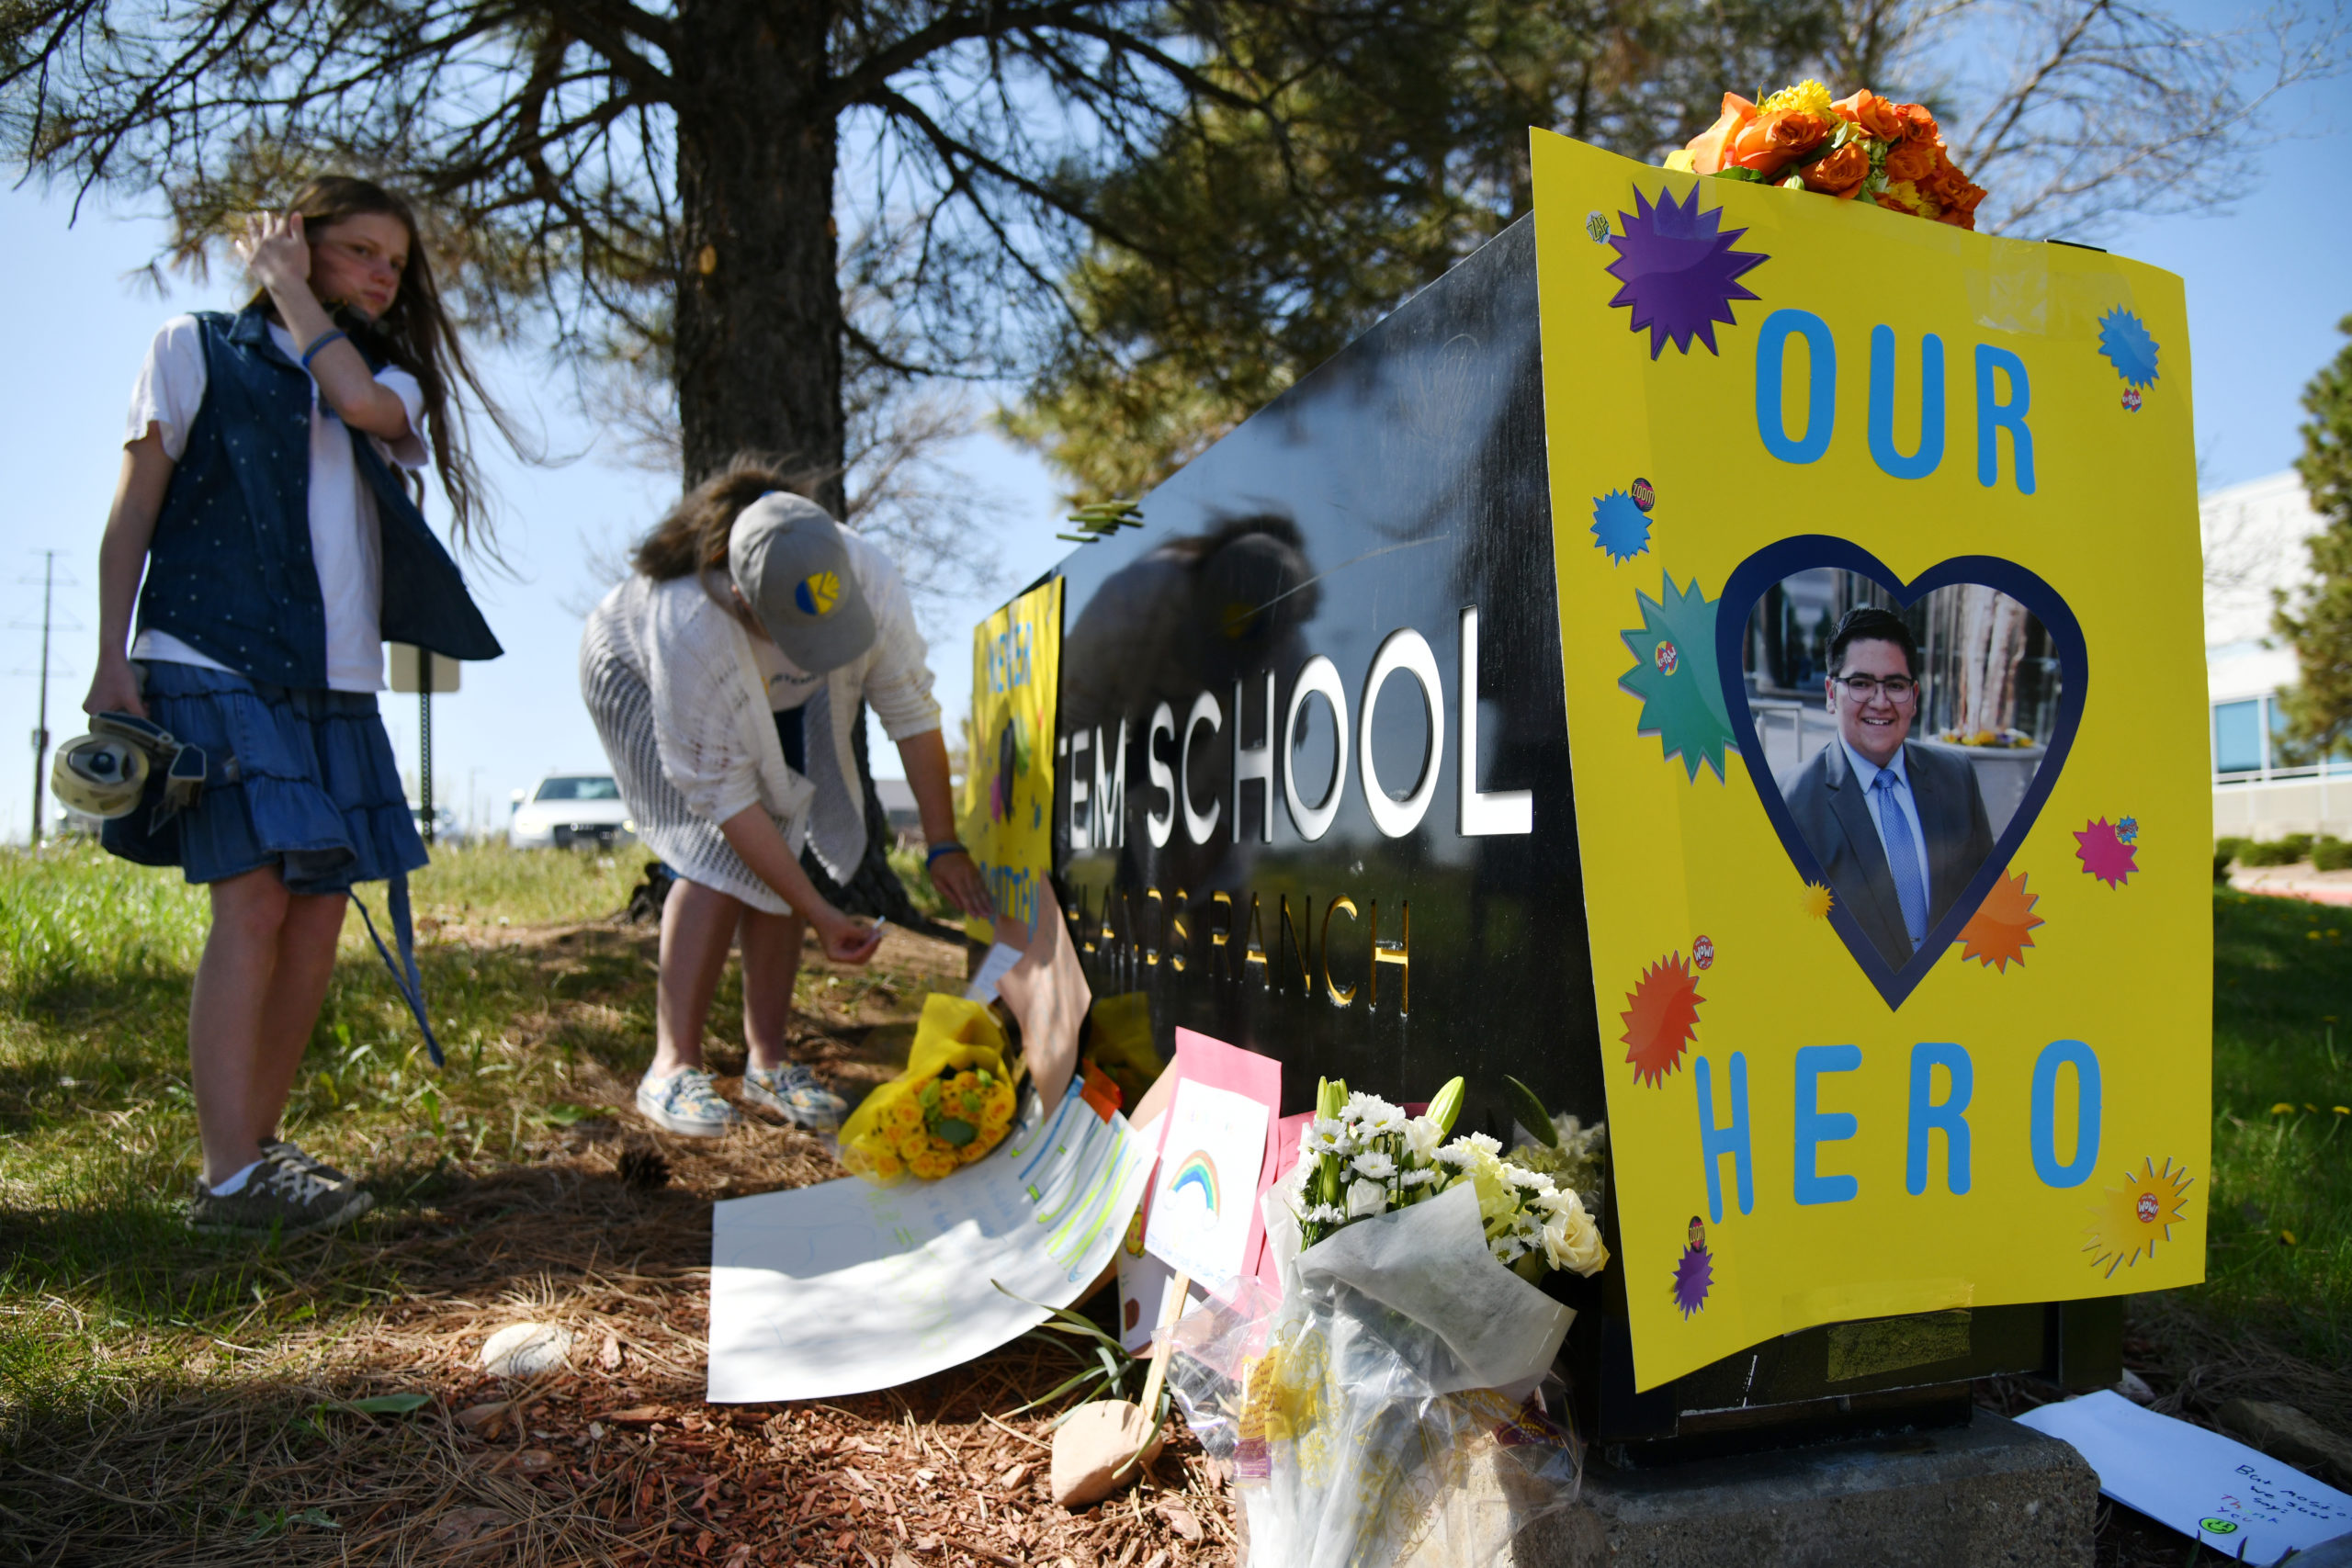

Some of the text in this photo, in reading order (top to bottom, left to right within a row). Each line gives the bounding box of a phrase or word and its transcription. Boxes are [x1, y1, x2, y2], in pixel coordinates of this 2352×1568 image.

[1587, 214, 1609, 242] ZAP
[1754, 309, 2037, 495] OUR
[1632, 482, 1655, 505] ZOOM
[988, 622, 1033, 694] NEVER
[1147, 604, 1533, 849] SCHOOL
[1208, 891, 1409, 1017] RANCH
[1693, 945, 1714, 963] WOW!
[1694, 1039, 2103, 1224] HERO
[2138, 1201, 2159, 1214] WOW!
[2234, 1464, 2272, 1485] But
